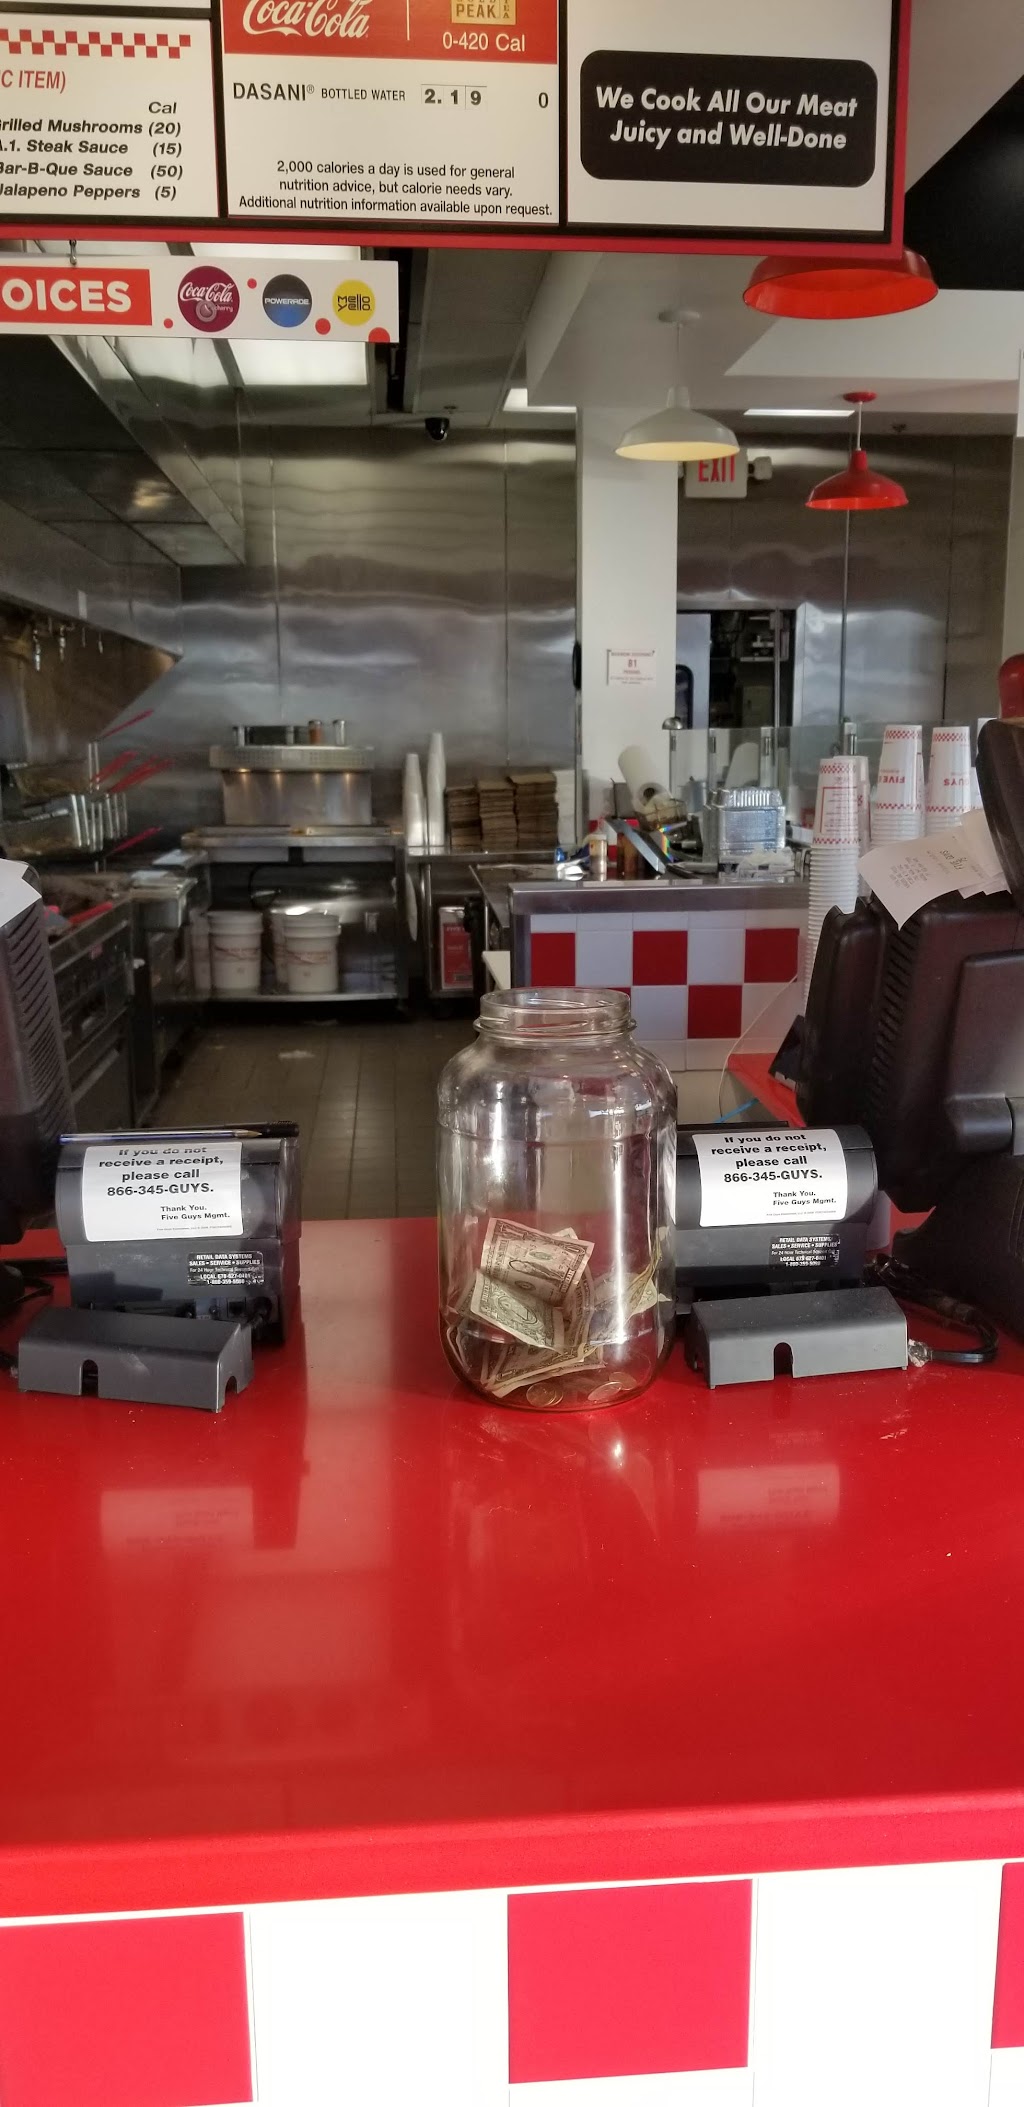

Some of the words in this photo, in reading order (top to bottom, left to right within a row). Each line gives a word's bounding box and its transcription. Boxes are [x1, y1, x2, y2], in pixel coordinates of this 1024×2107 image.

[456, 4, 496, 18] PEAK
[442, 32, 488, 50] 0-420
[496, 33, 526, 52] Cal
[18, 70, 66, 94] ITEM)
[321, 87, 367, 100] BOTTLED
[371, 90, 406, 101] WATER
[538, 92, 550, 108] 0
[148, 101, 177, 114] Cal
[596, 86, 634, 110] We
[640, 88, 701, 112] Cook
[706, 89, 740, 113] All
[746, 92, 792, 115] Our
[796, 94, 858, 117] Meat
[0, 118, 42, 132] rilled
[48, 119, 143, 134] Mushrooms
[148, 122, 182, 138] (20)
[610, 120, 672, 150] Juicy
[677, 122, 724, 145] and
[730, 124, 847, 150] Well-Done
[26, 140, 74, 153] Steak
[78, 140, 128, 154] Sauce
[152, 142, 182, 158] (15)
[83, 162, 134, 176] Sauce
[150, 165, 183, 180] (50)
[277, 160, 313, 174] 2,000
[316, 161, 364, 174] calories
[368, 164, 375, 174] a
[379, 163, 400, 178] day
[404, 164, 414, 176] is
[417, 164, 446, 176] used
[450, 165, 466, 176] for
[470, 166, 515, 180] general
[73, 184, 140, 200] Peppers
[154, 186, 177, 201] (5)
[280, 179, 329, 192] nutrition
[332, 180, 376, 194] advice,
[379, 181, 398, 193] but
[402, 182, 442, 194] calorie
[446, 184, 482, 196] needs
[486, 186, 512, 199] vary.
[238, 196, 296, 208] Additional
[300, 198, 348, 210] nutrition
[352, 198, 416, 212] information
[420, 200, 470, 213] available
[474, 204, 502, 216] upon
[506, 204, 552, 218] request.
[264, 298, 310, 306] POWERADE
[883, 776, 906, 784] FIVE
[738, 1136, 762, 1144] you
[712, 1146, 760, 1154] receive
[776, 1142, 827, 1152] receipt,
[99, 1158, 152, 1167] receive
[170, 1156, 224, 1166] receipt,
[736, 1158, 779, 1169] please
[784, 1156, 808, 1165] call
[122, 1171, 170, 1182] please
[174, 1168, 200, 1179] call
[724, 1169, 822, 1182] 866-345-GUYS.
[107, 1182, 214, 1196] 866-345-GUYS.
[204, 1212, 230, 1220] Mgmt.
